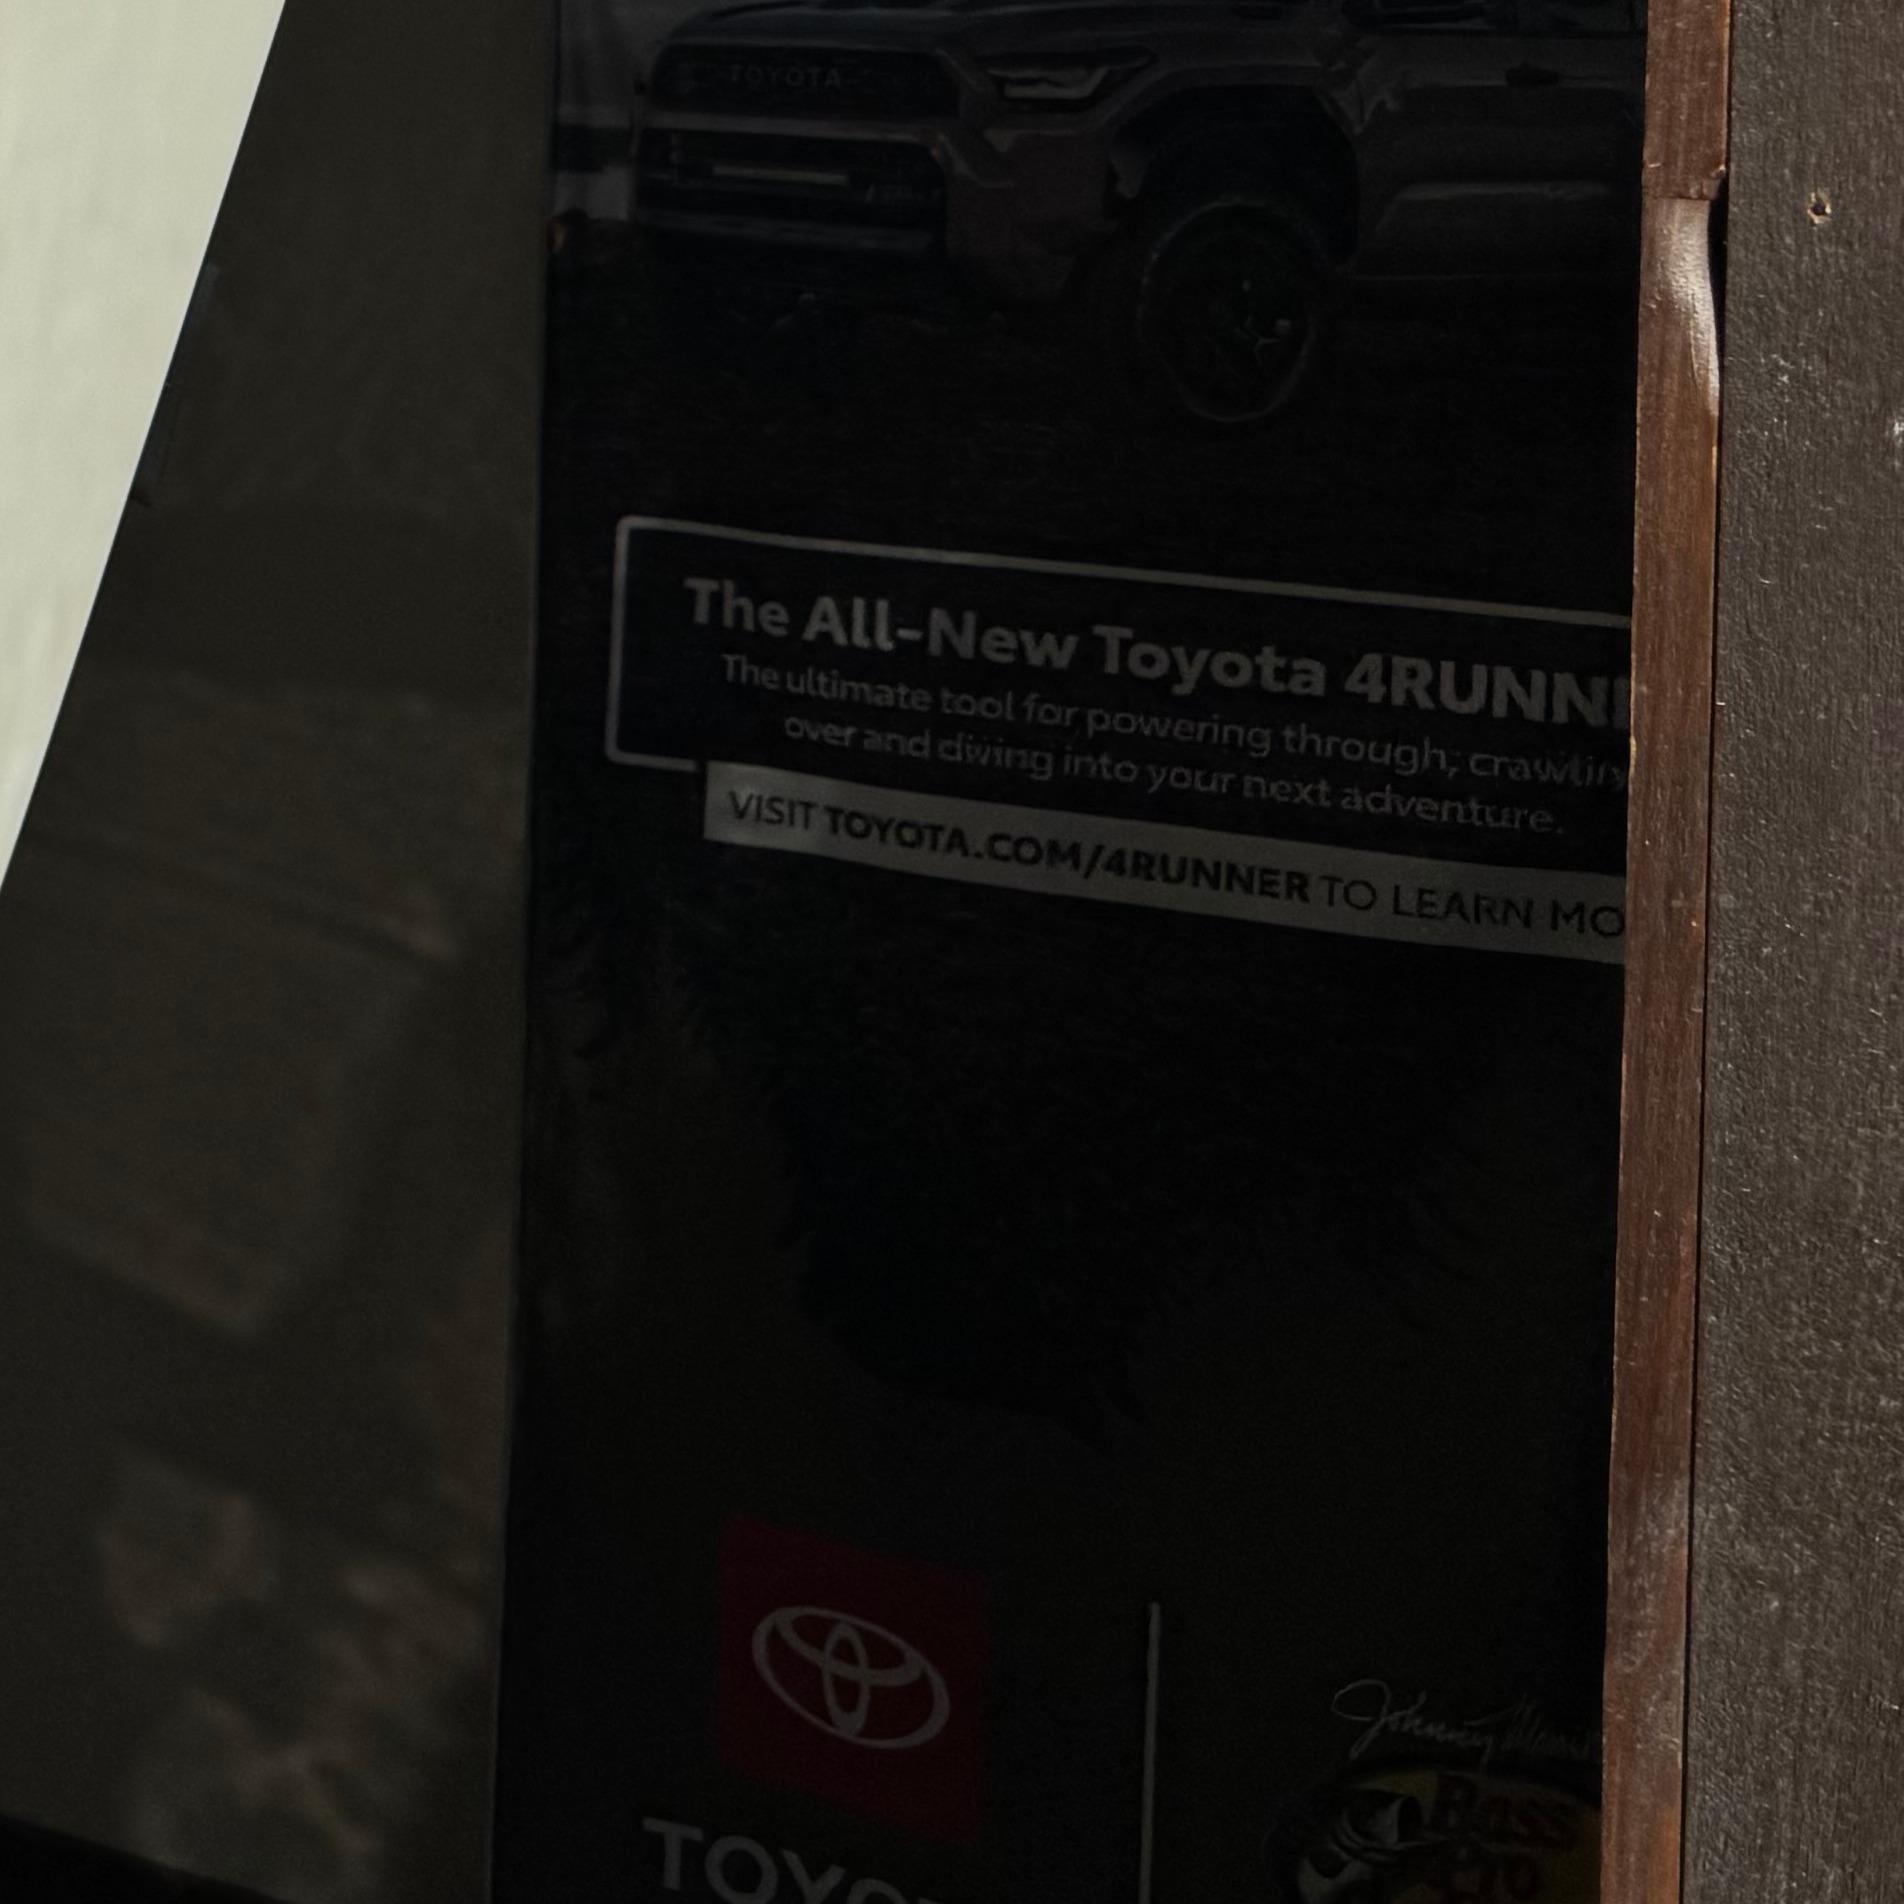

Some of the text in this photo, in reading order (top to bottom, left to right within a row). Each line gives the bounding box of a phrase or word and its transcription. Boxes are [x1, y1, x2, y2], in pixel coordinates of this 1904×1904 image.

[683, 576, 790, 637] The
[801, 595, 1079, 670] All-New
[1091, 623, 1327, 697] Toyota
[720, 652, 780, 691] The
[785, 664, 933, 713] ultimate
[941, 689, 1014, 721] tool
[1021, 693, 1079, 728] for
[1088, 705, 1272, 758] powering
[1281, 722, 1459, 780] through,
[784, 714, 1564, 836] over and diving into your next adventure.
[728, 789, 817, 831] VISIT
[824, 805, 1310, 904] TOYOTA.COM/4RUNNER
[1320, 874, 1378, 912] TO
[1392, 883, 1533, 930] LEARN
[642, 1816, 947, 1904] TOY
